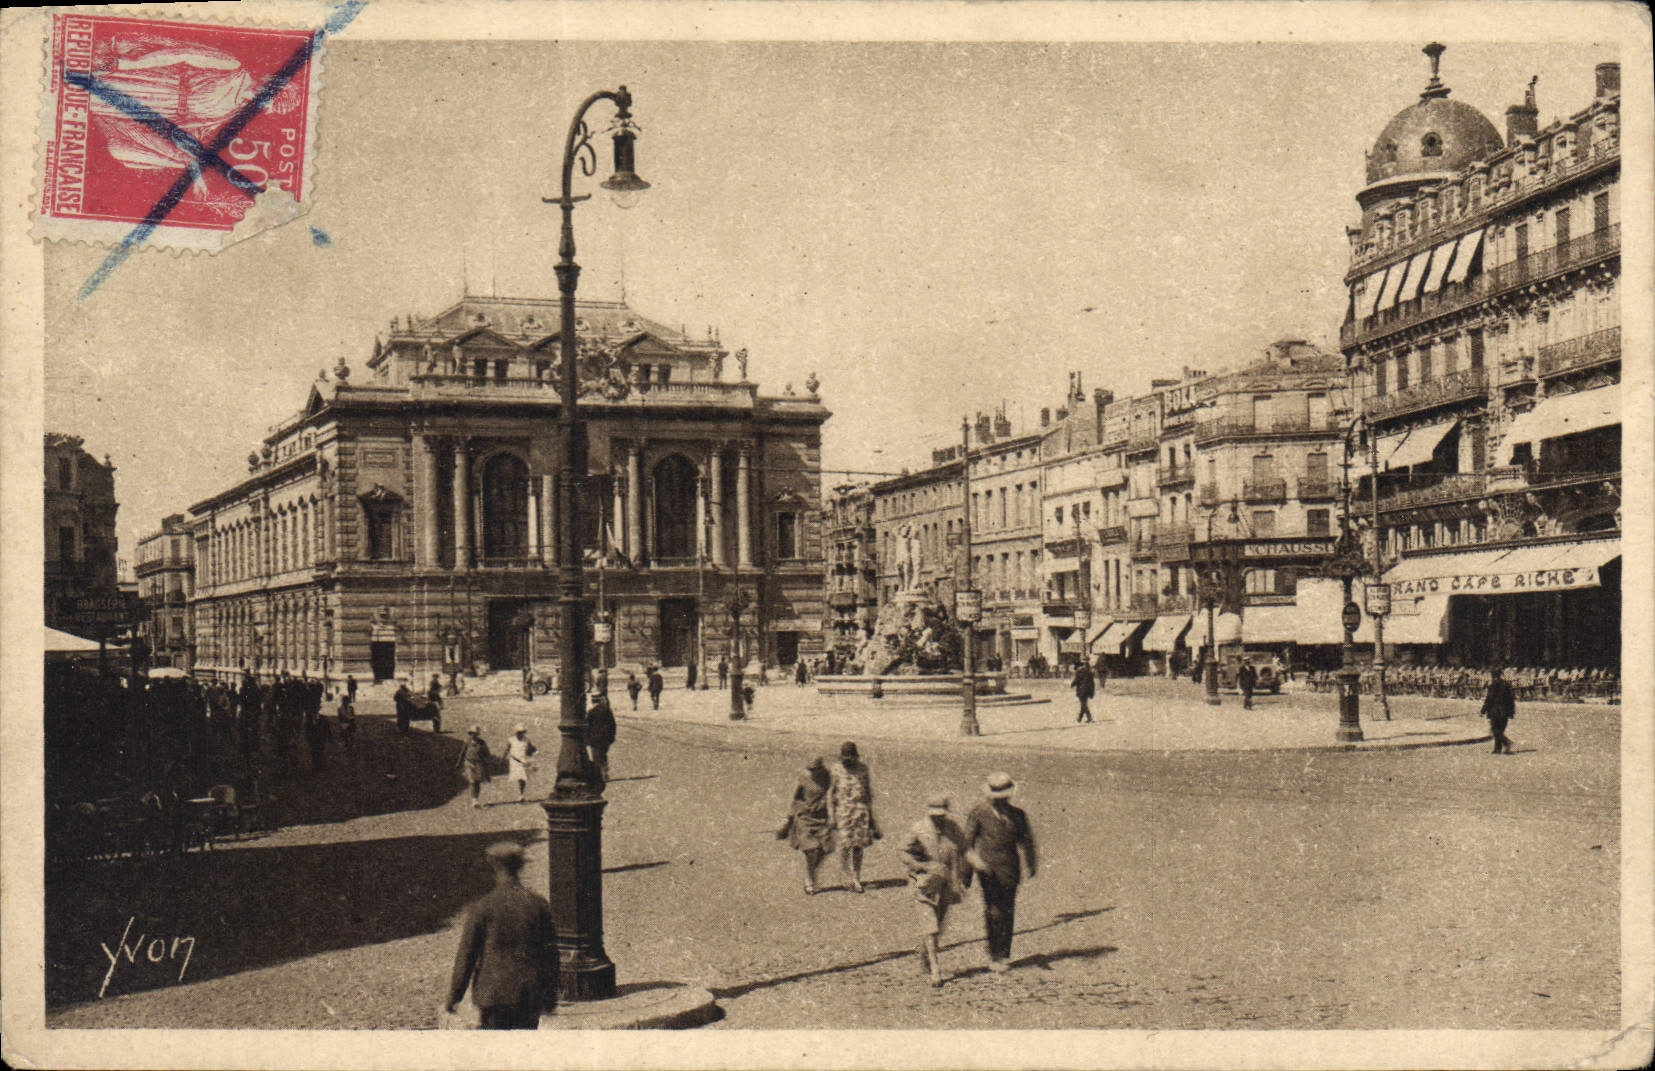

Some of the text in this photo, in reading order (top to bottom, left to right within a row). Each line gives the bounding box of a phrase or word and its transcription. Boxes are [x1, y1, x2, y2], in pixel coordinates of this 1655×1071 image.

[56, 116, 89, 213] FRANÇAISE
[227, 138, 271, 188] 50
[279, 127, 296, 189] POST
[1392, 577, 1439, 595] RAND
[1514, 570, 1576, 587] RICHE
